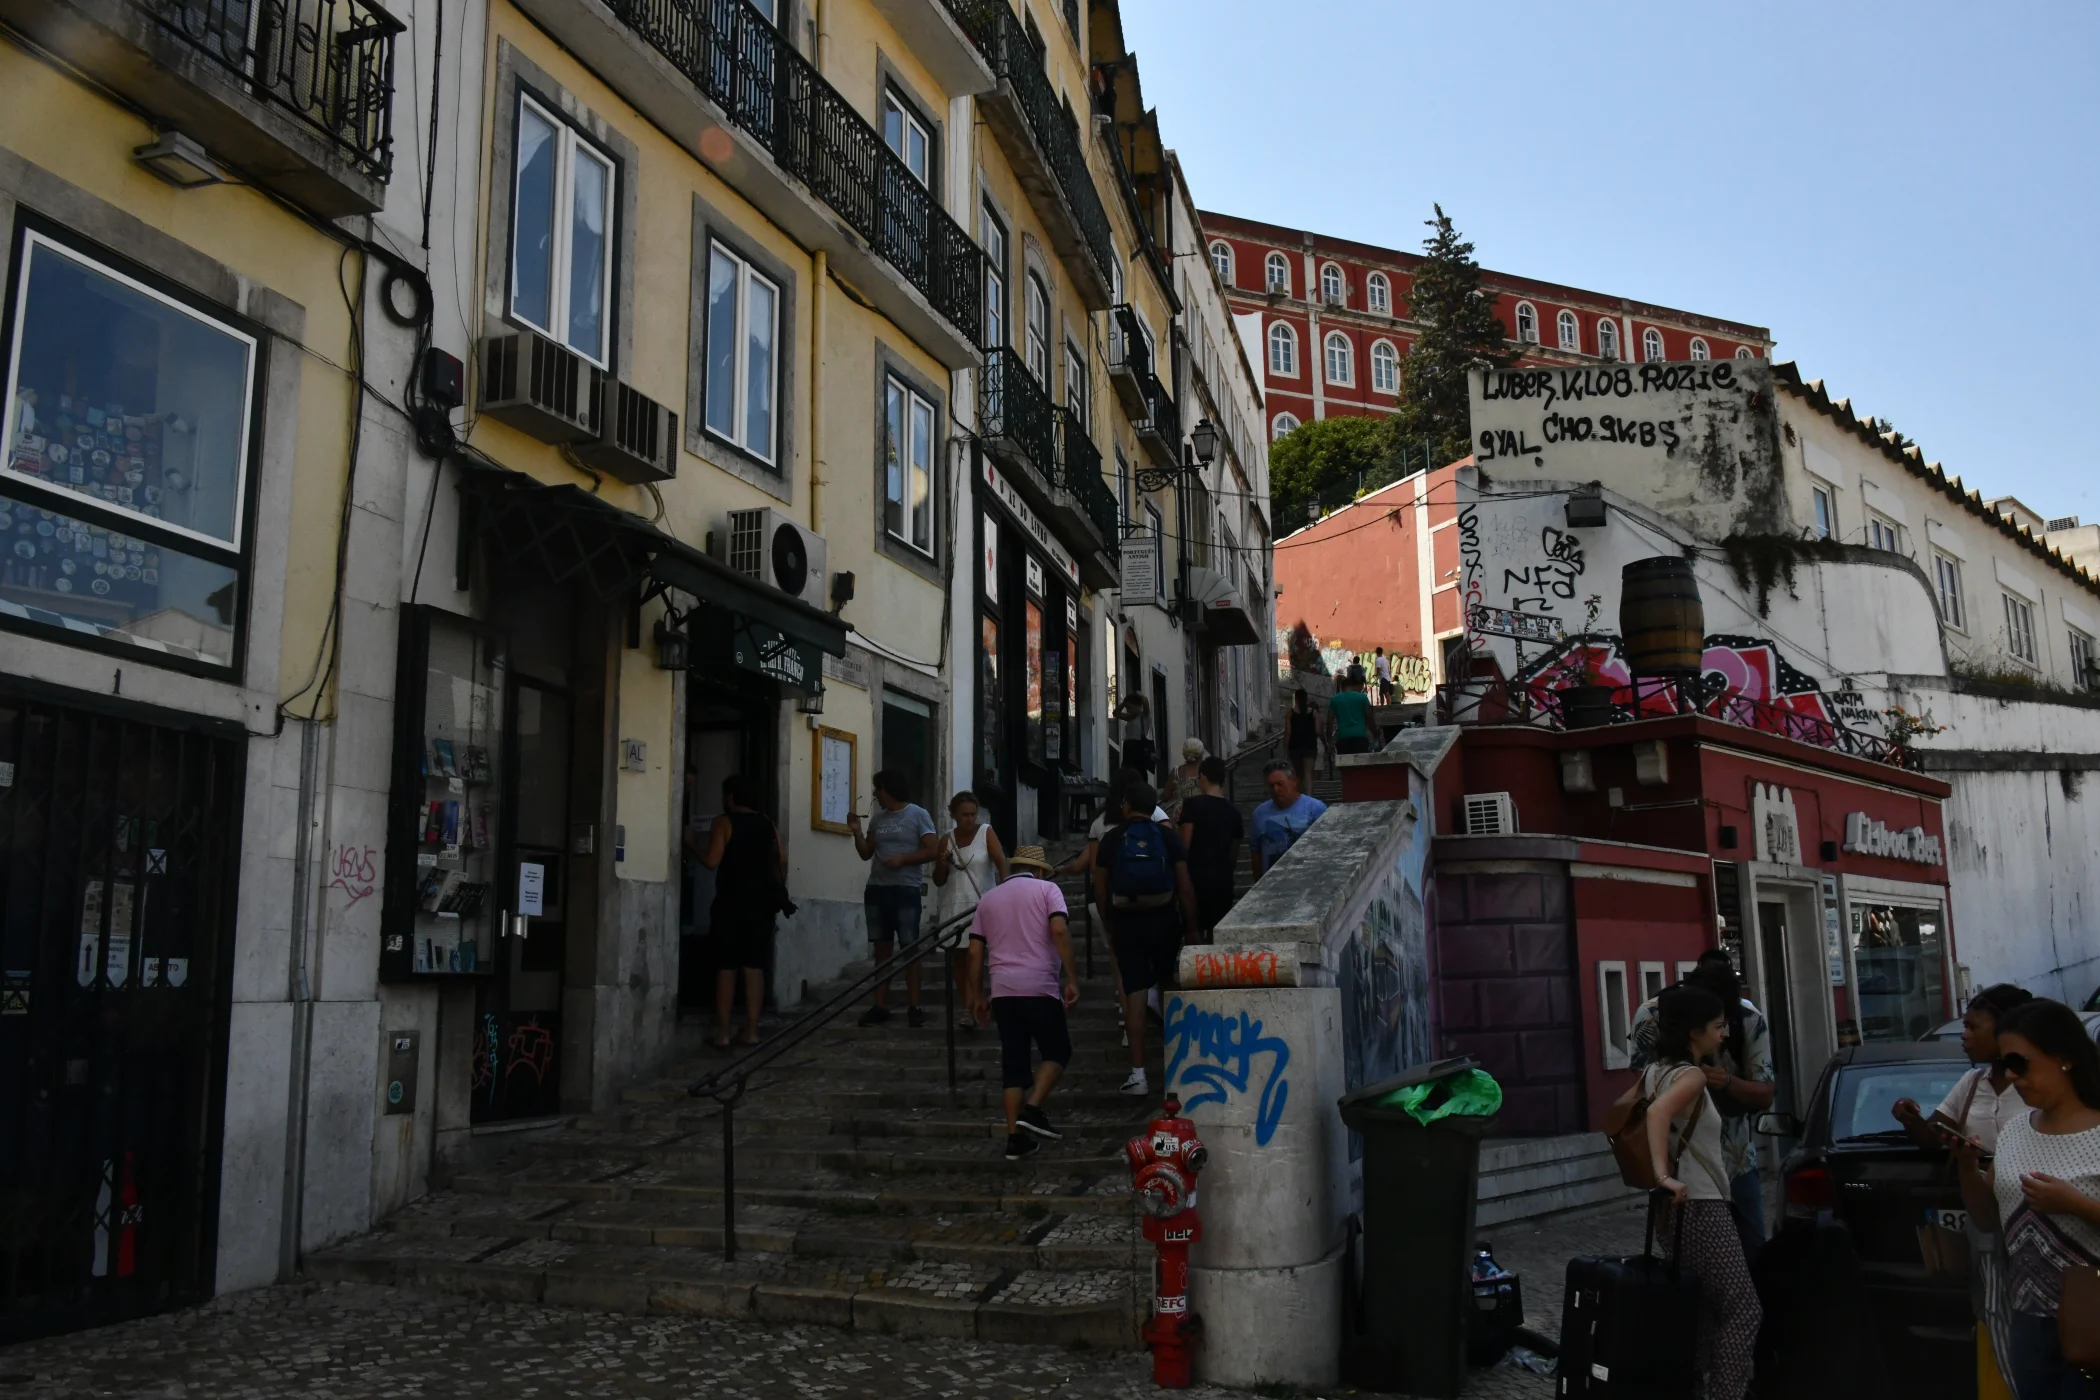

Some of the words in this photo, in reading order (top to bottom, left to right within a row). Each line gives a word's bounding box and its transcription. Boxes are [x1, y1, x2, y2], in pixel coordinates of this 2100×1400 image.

[1031, 515, 1048, 545] LIVRO
[629, 744, 643, 761] AL
[148, 963, 179, 972] ABTO
